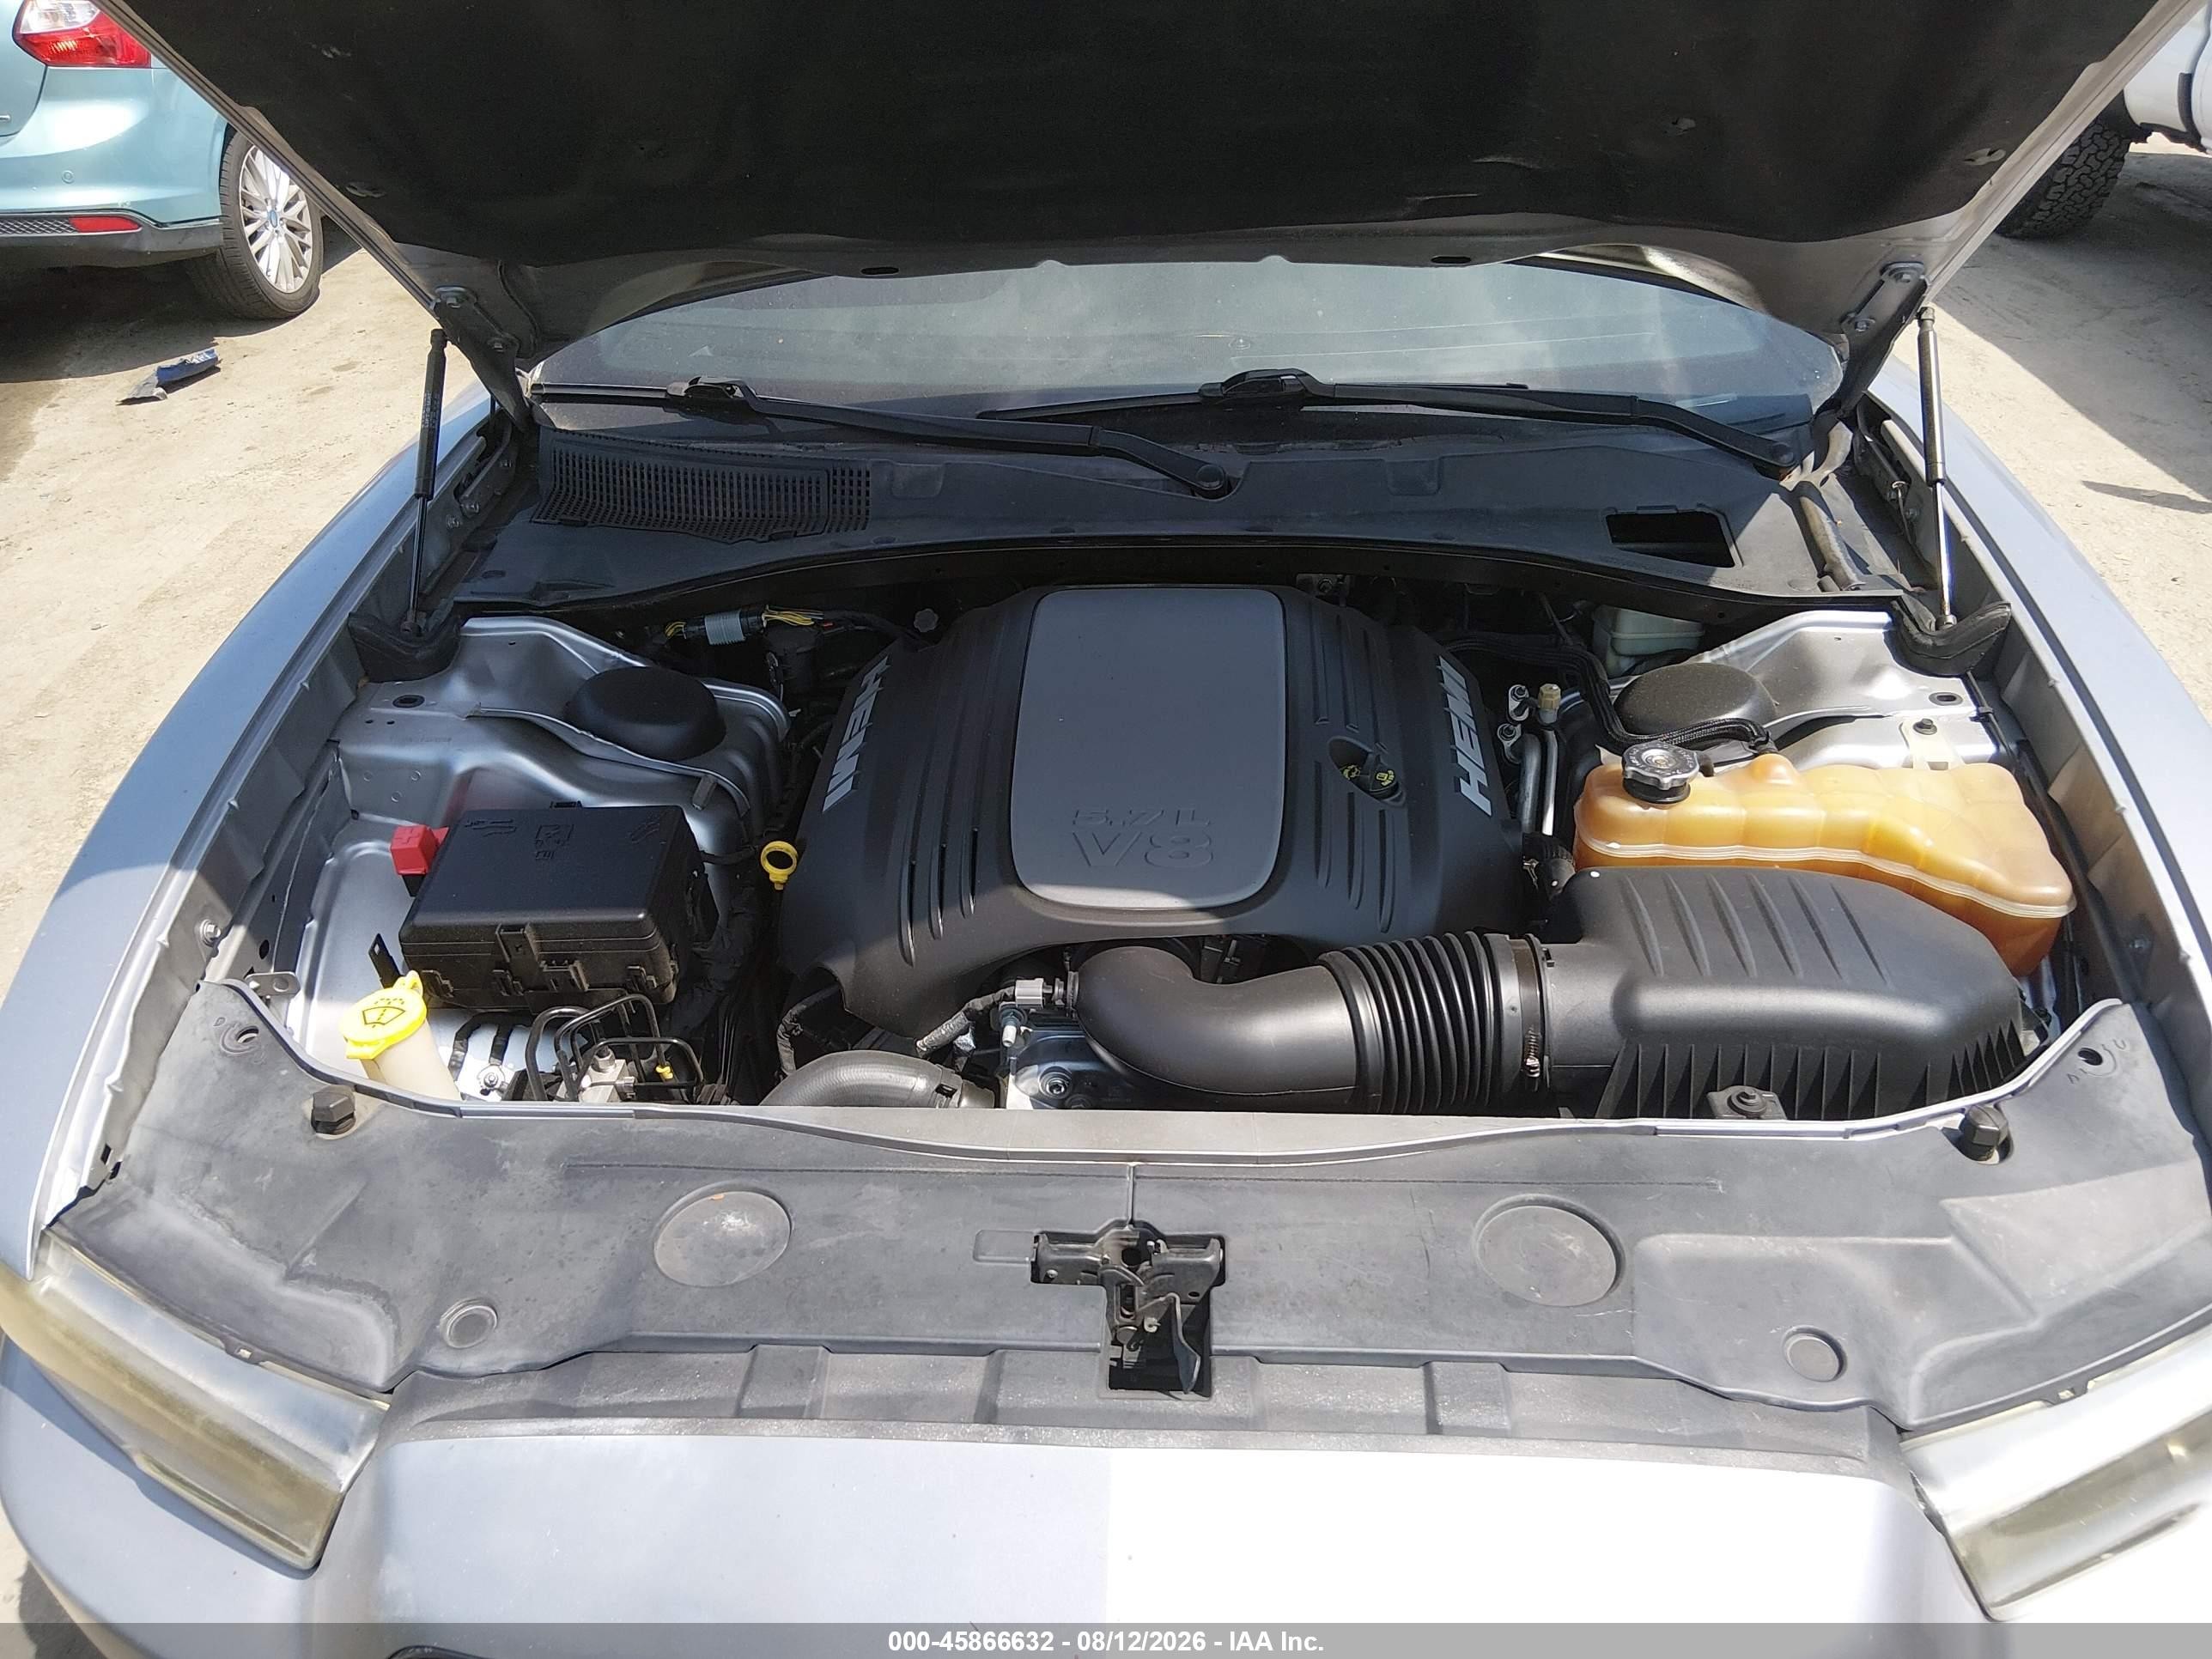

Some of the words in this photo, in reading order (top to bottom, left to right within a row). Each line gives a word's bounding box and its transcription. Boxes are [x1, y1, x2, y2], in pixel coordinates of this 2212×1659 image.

[822, 655, 890, 811] HEMI
[1437, 655, 1492, 817] HEMI
[1073, 830, 1213, 869] V8
